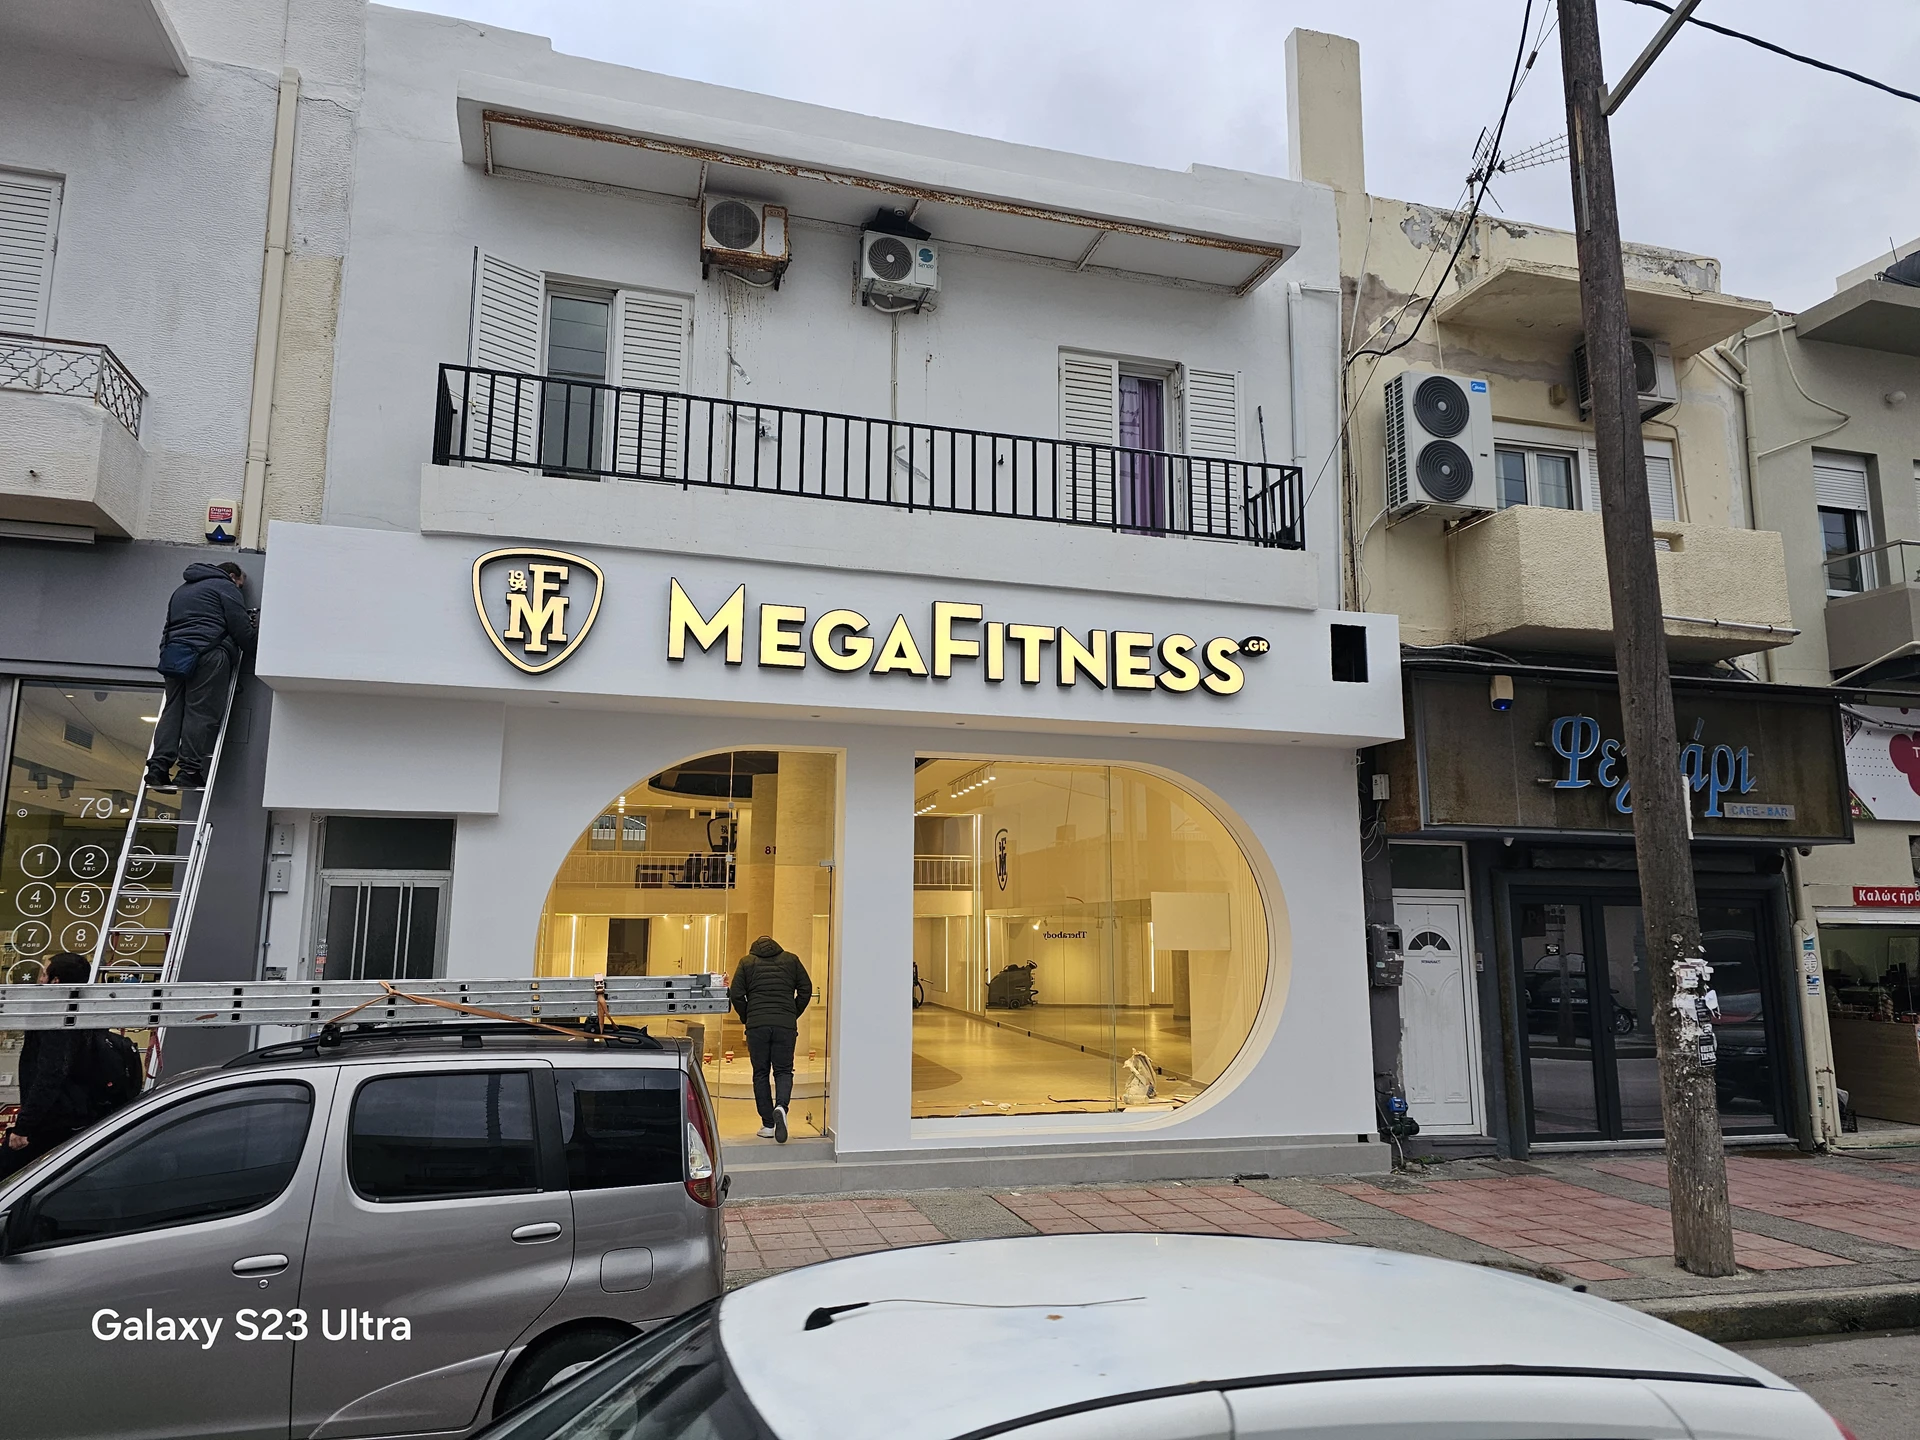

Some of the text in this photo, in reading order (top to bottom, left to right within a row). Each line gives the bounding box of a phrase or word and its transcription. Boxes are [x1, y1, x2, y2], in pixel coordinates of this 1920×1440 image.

[79, 797, 113, 819] 79
[765, 846, 777, 855] 81
[36, 852, 44, 865] 1
[84, 852, 95, 866] 2
[30, 889, 41, 903] 4
[80, 890, 90, 903] 5
[1859, 890, 1897, 903] Καλώς
[27, 928, 38, 942] 7
[75, 928, 86, 942] 8
